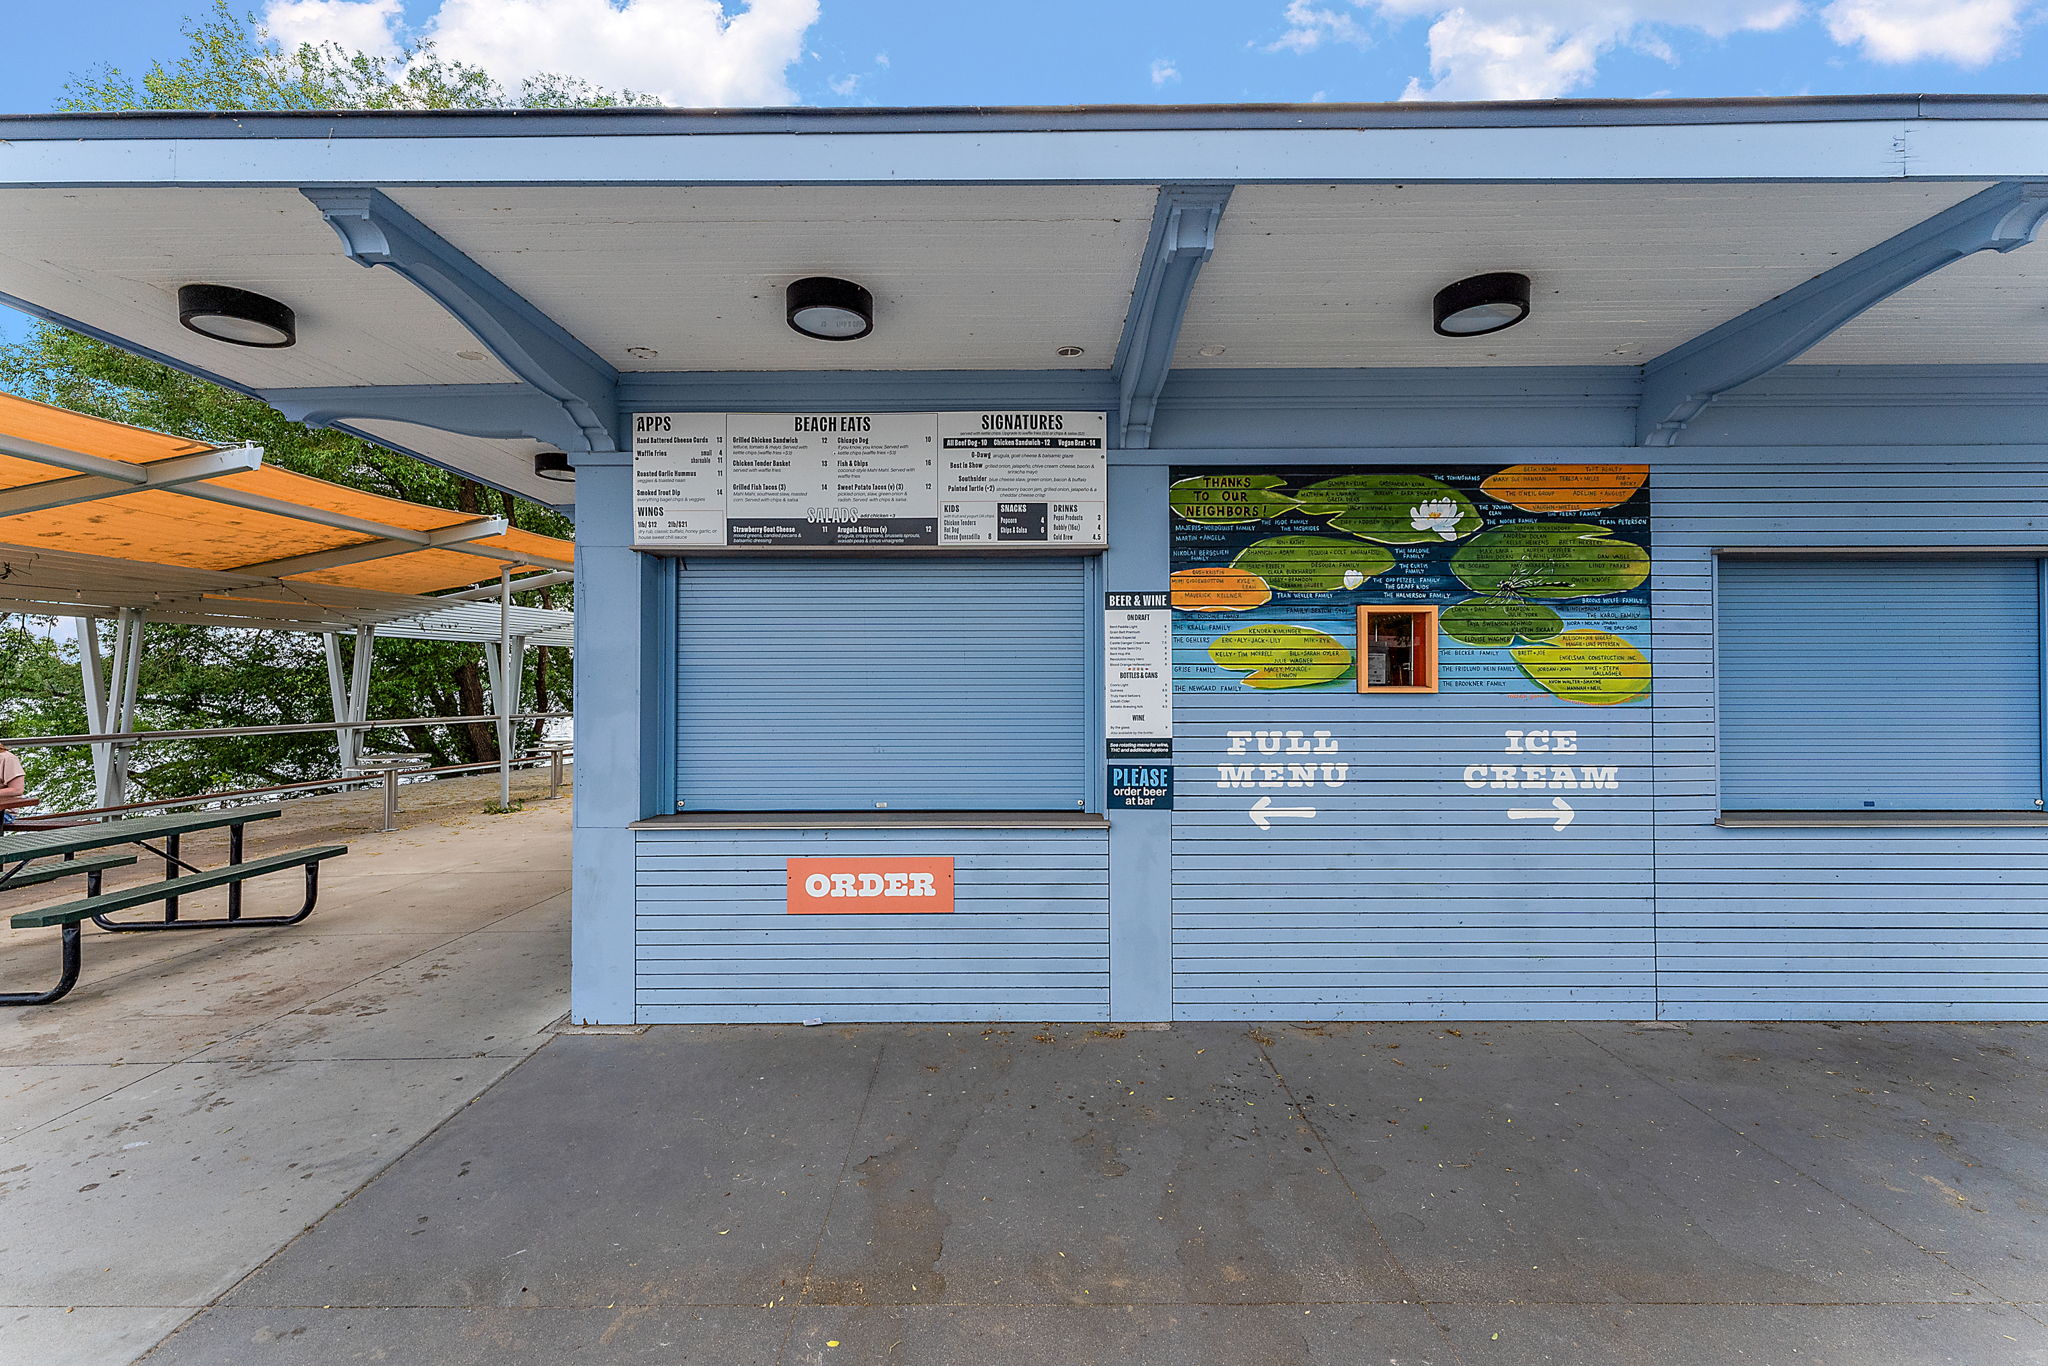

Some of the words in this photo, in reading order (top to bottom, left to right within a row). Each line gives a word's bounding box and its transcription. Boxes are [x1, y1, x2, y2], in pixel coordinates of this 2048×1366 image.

[636, 416, 672, 432] APPS
[794, 416, 837, 432] BEACH
[841, 416, 871, 432] EATS
[981, 414, 1063, 430] SIGNATURES
[673, 436, 693, 444] Cheese
[693, 436, 709, 444] Curds
[732, 436, 751, 444] Grilled
[751, 436, 772, 444] Chicken
[772, 436, 799, 444] Sandwich
[837, 437, 859, 445] Chicago
[858, 437, 869, 445] Dog
[946, 438, 955, 446] All
[954, 438, 967, 446] Beef
[967, 438, 978, 448] Dog
[981, 438, 988, 446] 10
[993, 438, 1015, 446] Chicken
[1015, 438, 1041, 446] Sandwich
[1058, 439, 1074, 448] Vegan
[1074, 439, 1086, 447] Brat
[853, 460, 869, 468] Chips
[732, 483, 751, 491] Grilled
[751, 483, 762, 491] Fish
[762, 483, 778, 491] Tacos
[778, 483, 787, 491] (3)
[1202, 477, 1251, 488] THANKS
[837, 483, 854, 491] Sweet
[854, 483, 872, 491] Potato
[872, 483, 887, 491] Tacos
[887, 483, 895, 492] (v)
[895, 483, 904, 491] (3)
[671, 489, 681, 497] Dip
[1193, 491, 1210, 502] TO
[1221, 491, 1249, 502] OUR
[637, 506, 664, 517] WINGS
[943, 504, 960, 513] KIDS
[1000, 504, 1027, 513] SNACKS
[1053, 504, 1078, 513] DRINKS
[807, 507, 859, 524] SALADS
[1053, 514, 1065, 522] Pepsi
[1000, 517, 1018, 525] Popcorn
[1040, 516, 1045, 524] 4
[732, 526, 763, 534] Strawberry
[837, 526, 859, 534] Arugula
[879, 526, 888, 534] (v)
[925, 525, 932, 533] 12
[1015, 526, 1028, 534] Salsa
[1040, 526, 1045, 534] 6
[1109, 595, 1132, 607] BEER
[1133, 595, 1141, 607] &
[1142, 594, 1167, 607] WINE
[1132, 714, 1145, 722] WINE
[1226, 730, 1339, 755] FULL
[1504, 729, 1578, 755] ICE
[1113, 768, 1168, 787] PLEASE
[1216, 763, 1349, 788] MENU
[1463, 763, 1619, 789] CREAM
[1113, 787, 1142, 796] order
[1143, 787, 1168, 796] beer
[1125, 796, 1136, 806] at
[1137, 796, 1155, 806] bar
[804, 872, 937, 898] ORDER
